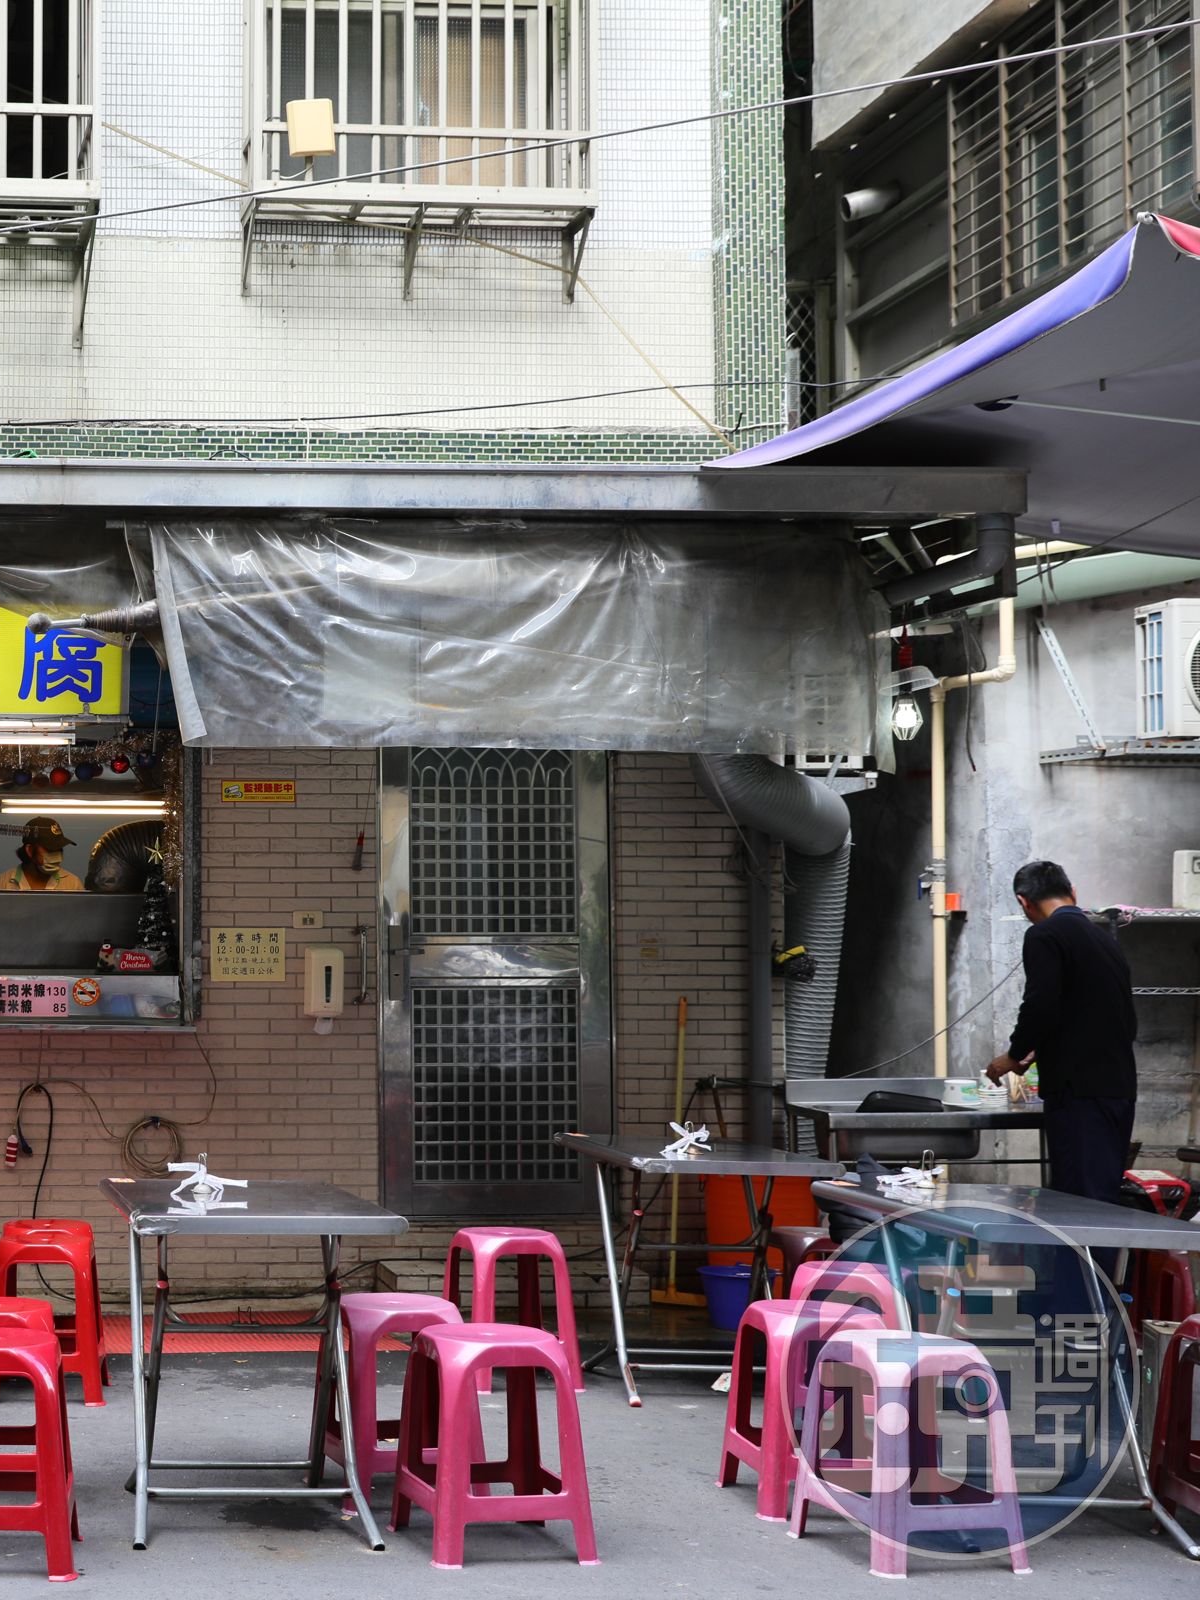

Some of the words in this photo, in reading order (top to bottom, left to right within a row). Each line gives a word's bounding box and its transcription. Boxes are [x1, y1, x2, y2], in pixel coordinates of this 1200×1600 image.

[244, 783, 293, 793] 監視錄影中
[217, 932, 279, 943] 營業時間
[123, 953, 146, 962] Merry
[120, 961, 151, 969] Christmas
[46, 986, 66, 996] 130
[53, 1003, 67, 1013] 85
